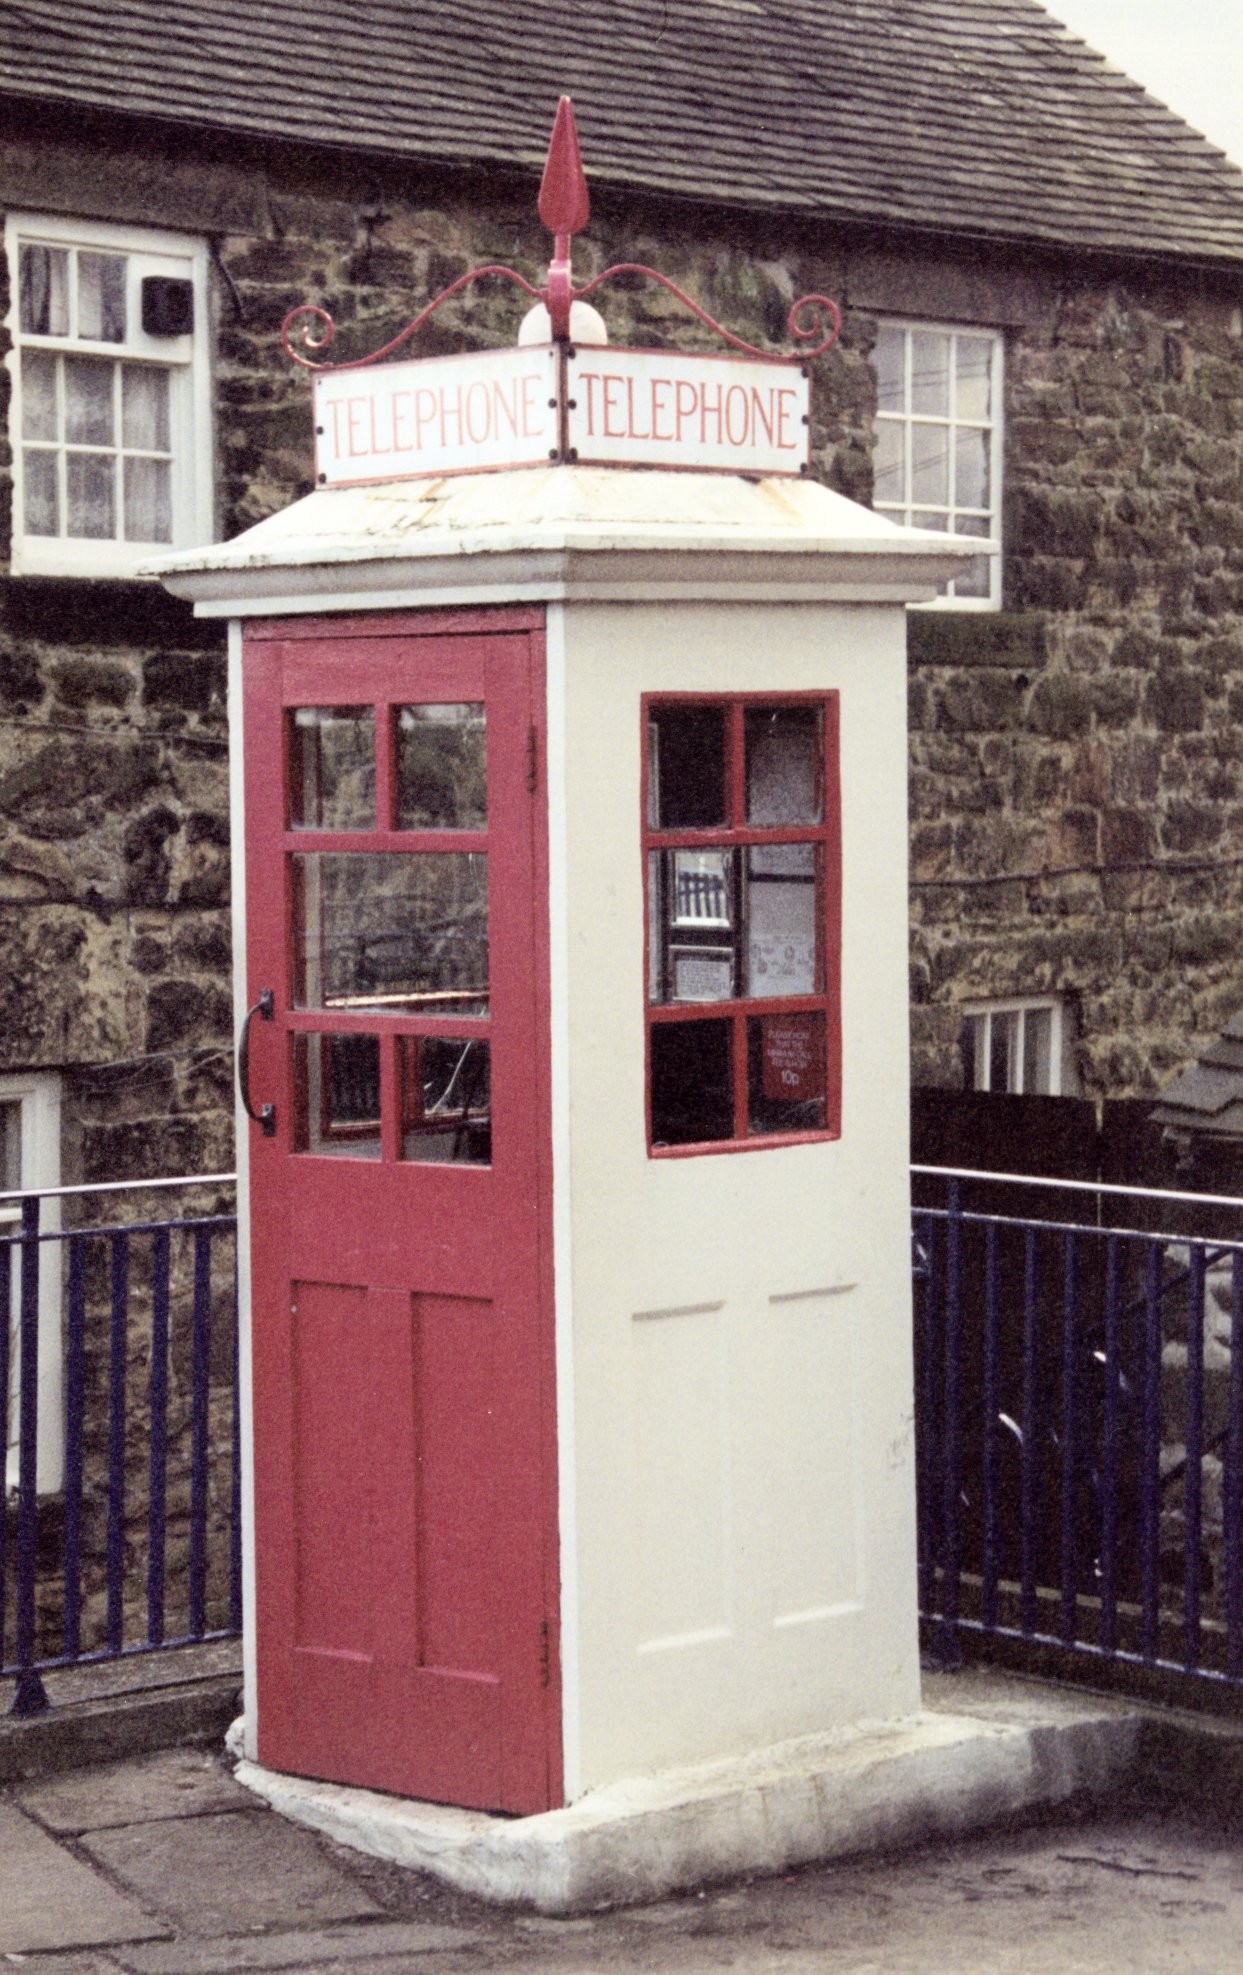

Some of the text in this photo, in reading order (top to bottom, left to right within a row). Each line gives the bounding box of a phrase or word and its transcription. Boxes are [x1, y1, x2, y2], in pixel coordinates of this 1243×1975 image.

[326, 374, 545, 459] TELEPHONE
[578, 373, 798, 449] TELEPHONE
[781, 1070, 799, 1086] 10p
